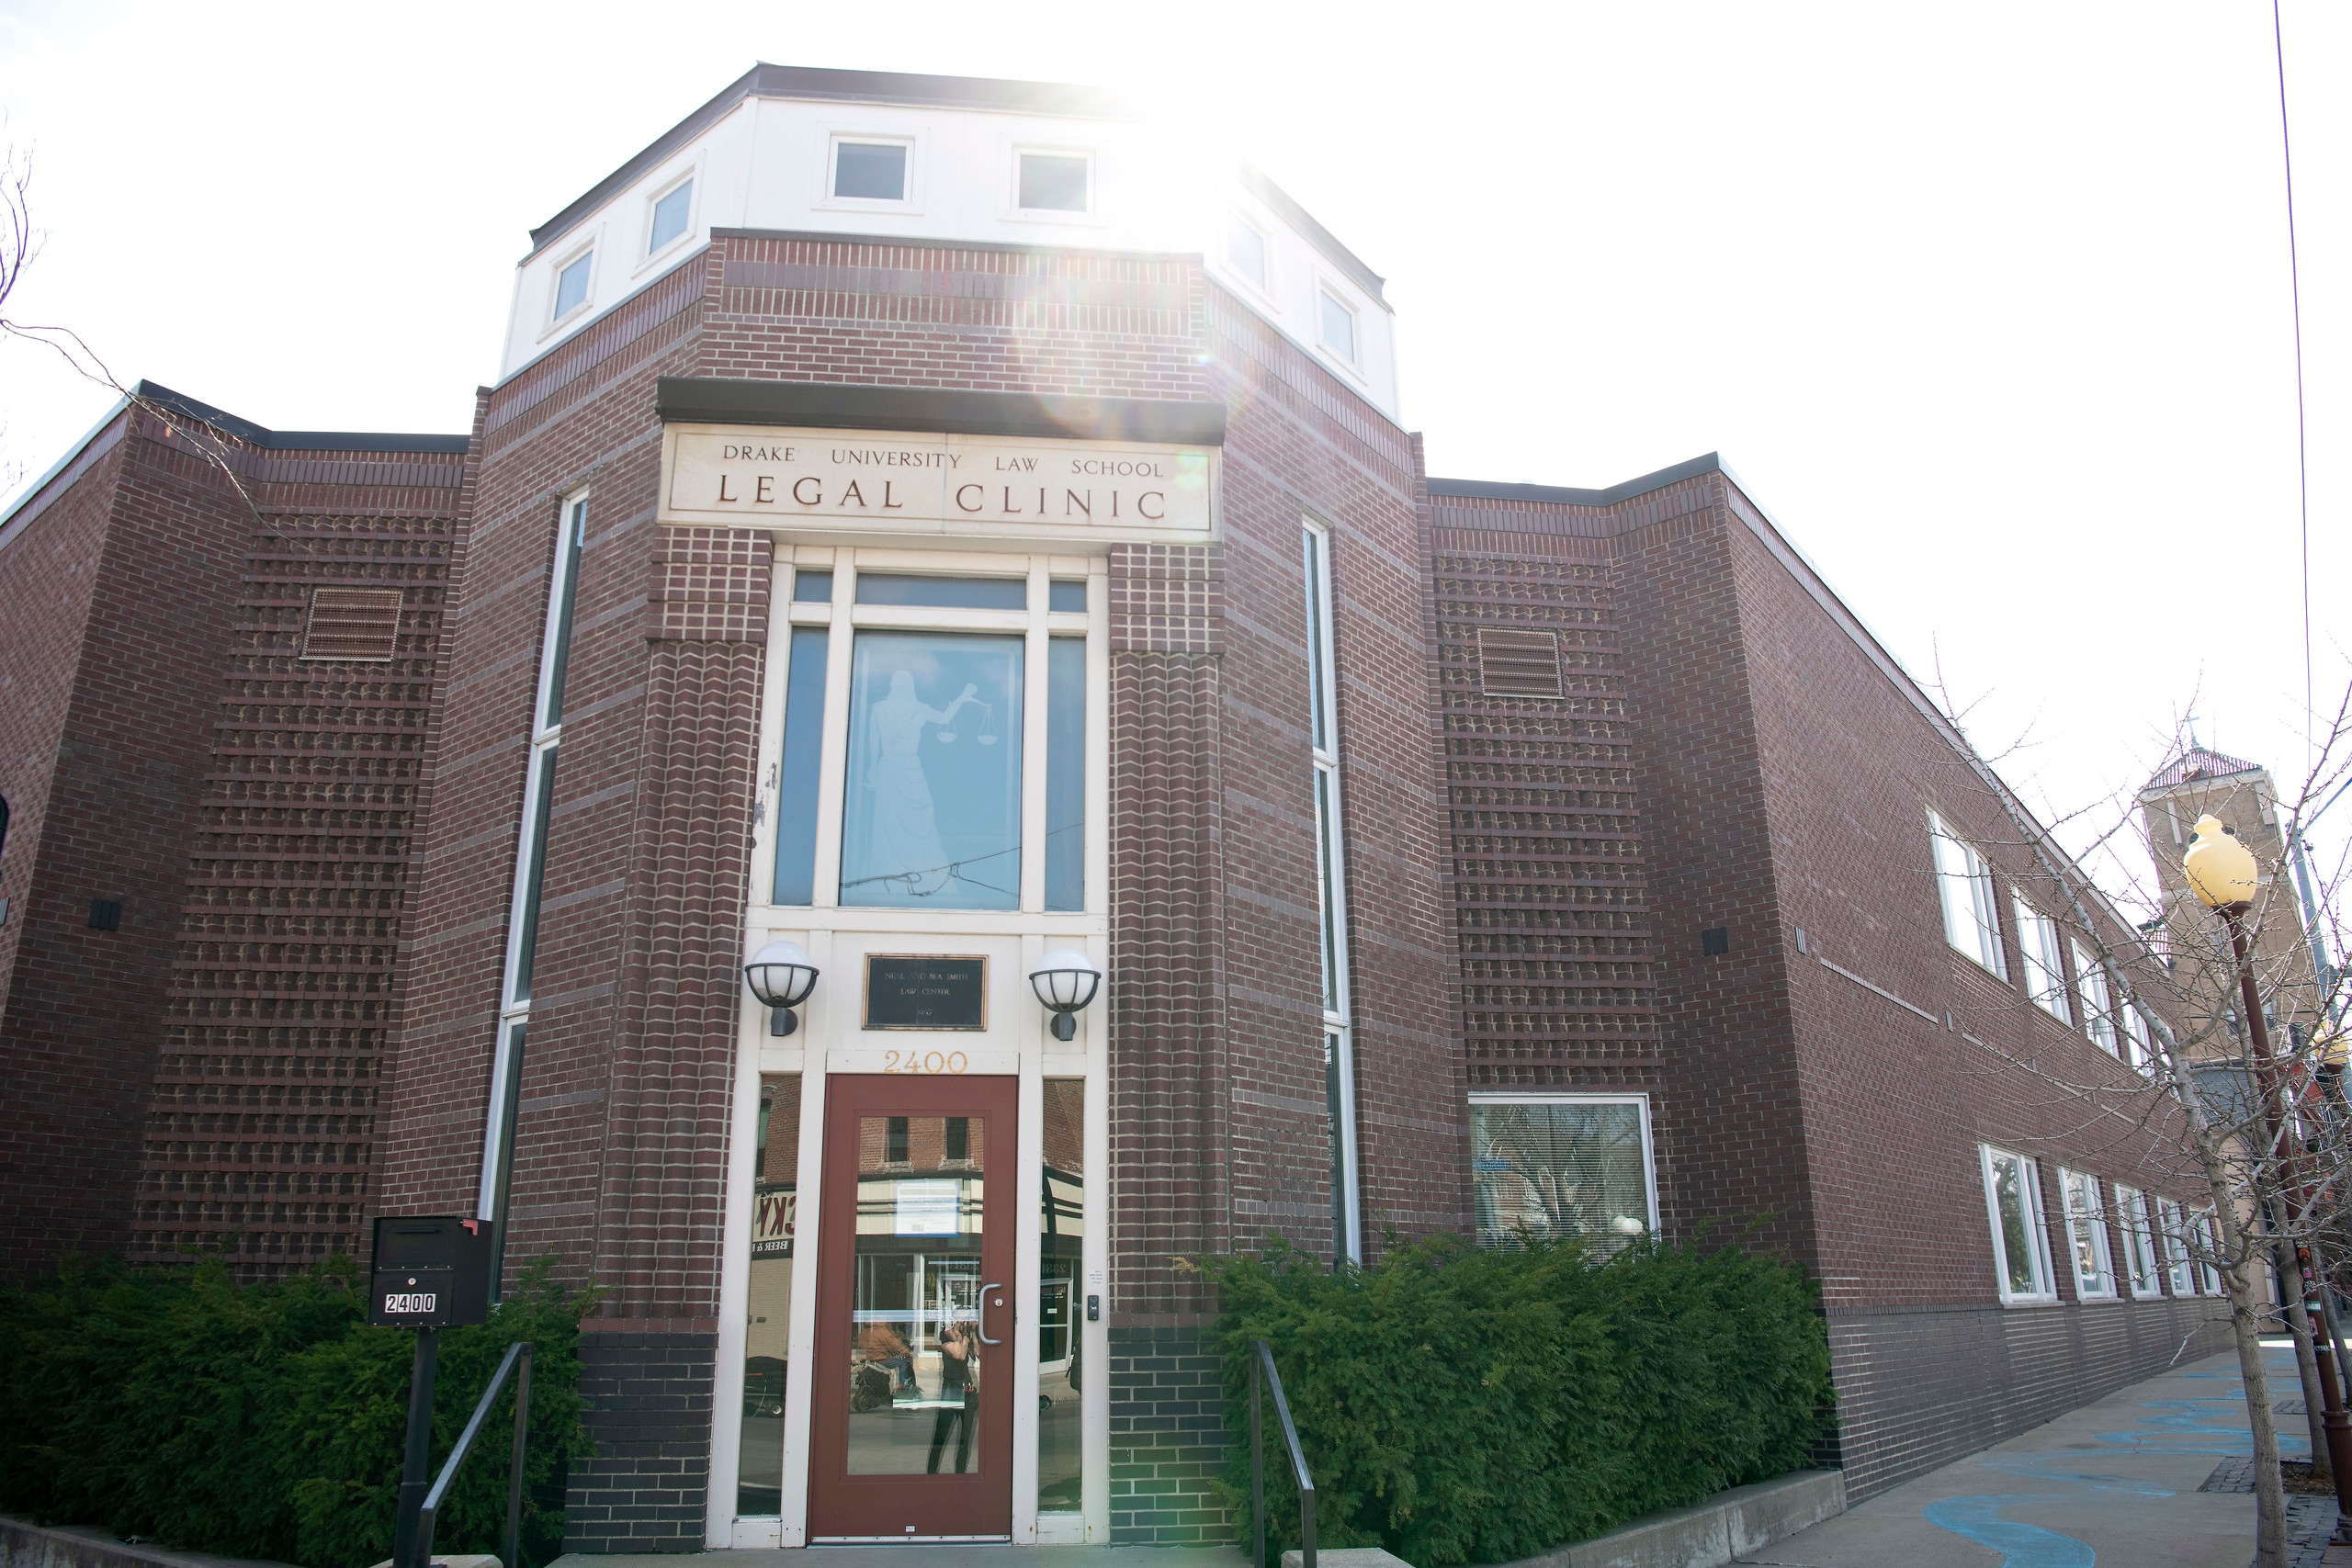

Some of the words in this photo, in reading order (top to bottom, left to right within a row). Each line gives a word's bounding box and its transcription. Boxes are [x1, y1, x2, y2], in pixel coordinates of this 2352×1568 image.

[723, 445, 796, 463] DRAKE
[831, 449, 963, 469] UNIVERSITY
[995, 457, 1039, 473] LAW
[1071, 459, 1165, 478] SCHOOL
[717, 474, 904, 509] LEGAL
[956, 483, 1166, 521] CLINIC
[946, 973, 968, 981] SMITH
[900, 987, 917, 996] LAW
[922, 987, 950, 996] CENTER
[884, 1050, 968, 1074] 2400
[386, 1294, 434, 1312] 2400
